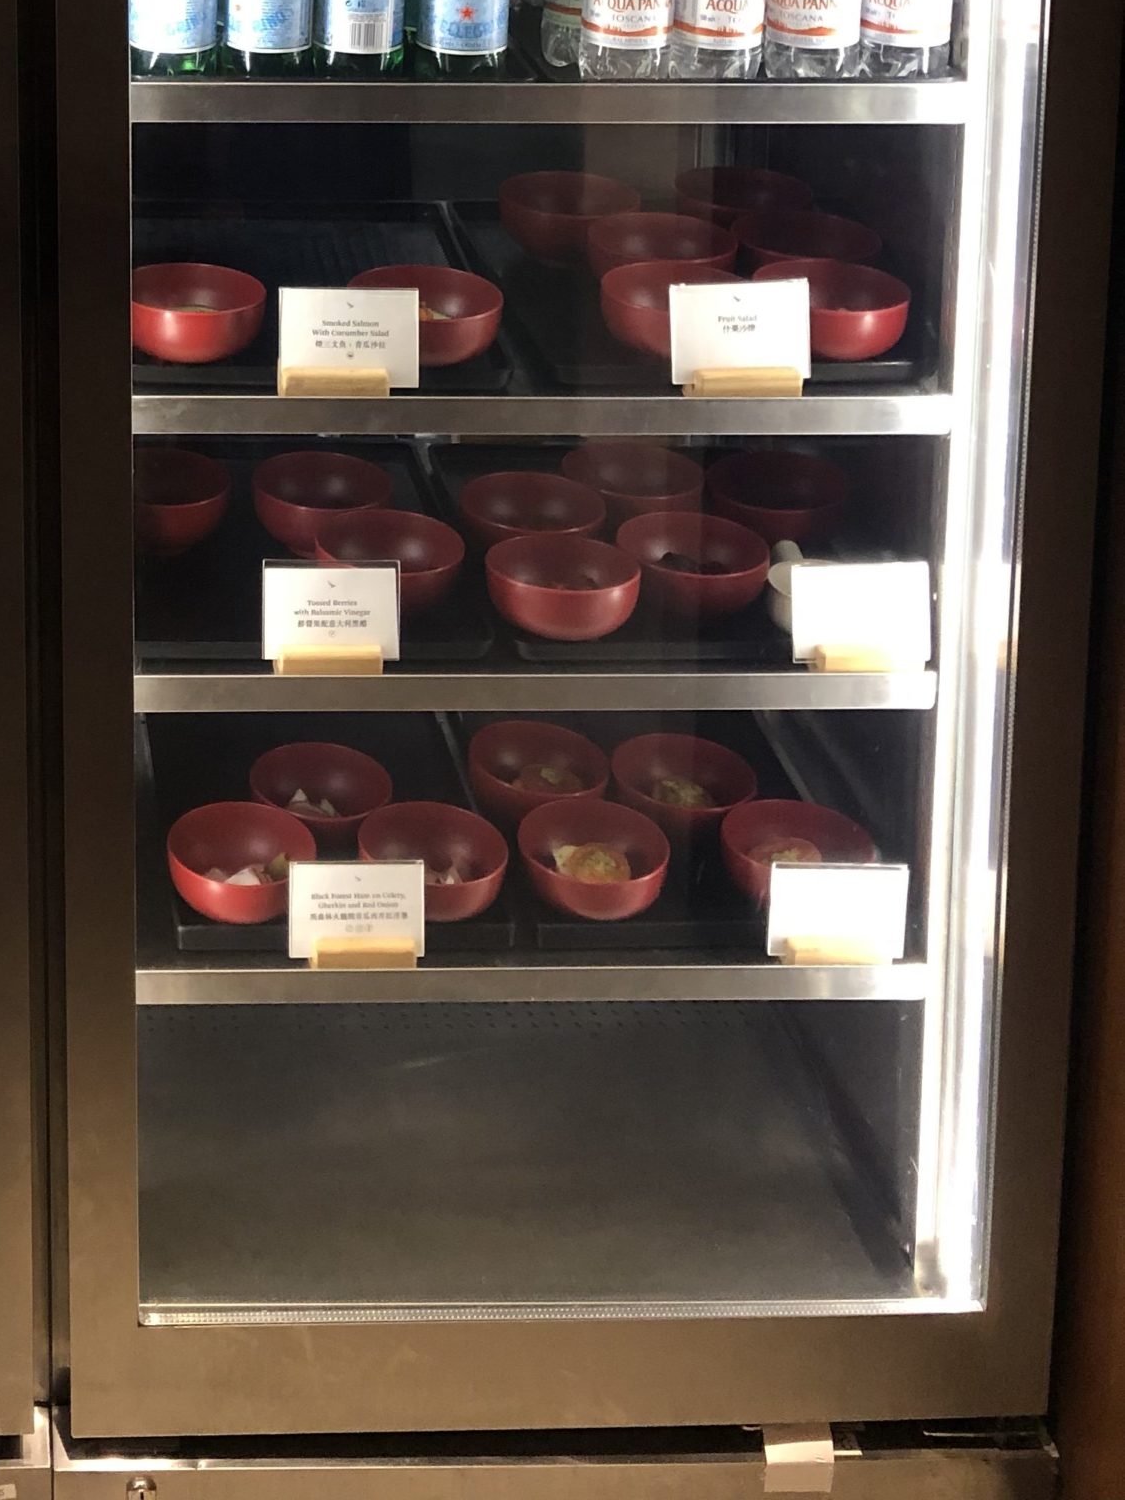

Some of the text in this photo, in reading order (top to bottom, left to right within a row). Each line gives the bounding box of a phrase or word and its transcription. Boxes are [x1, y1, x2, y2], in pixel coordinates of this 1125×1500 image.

[322, 319, 379, 328] Smoked Salmon
[331, 329, 369, 337] Cucumber
[370, 329, 389, 337] Salad
[311, 609, 342, 617] Balsamic
[344, 609, 371, 618] Vinegar
